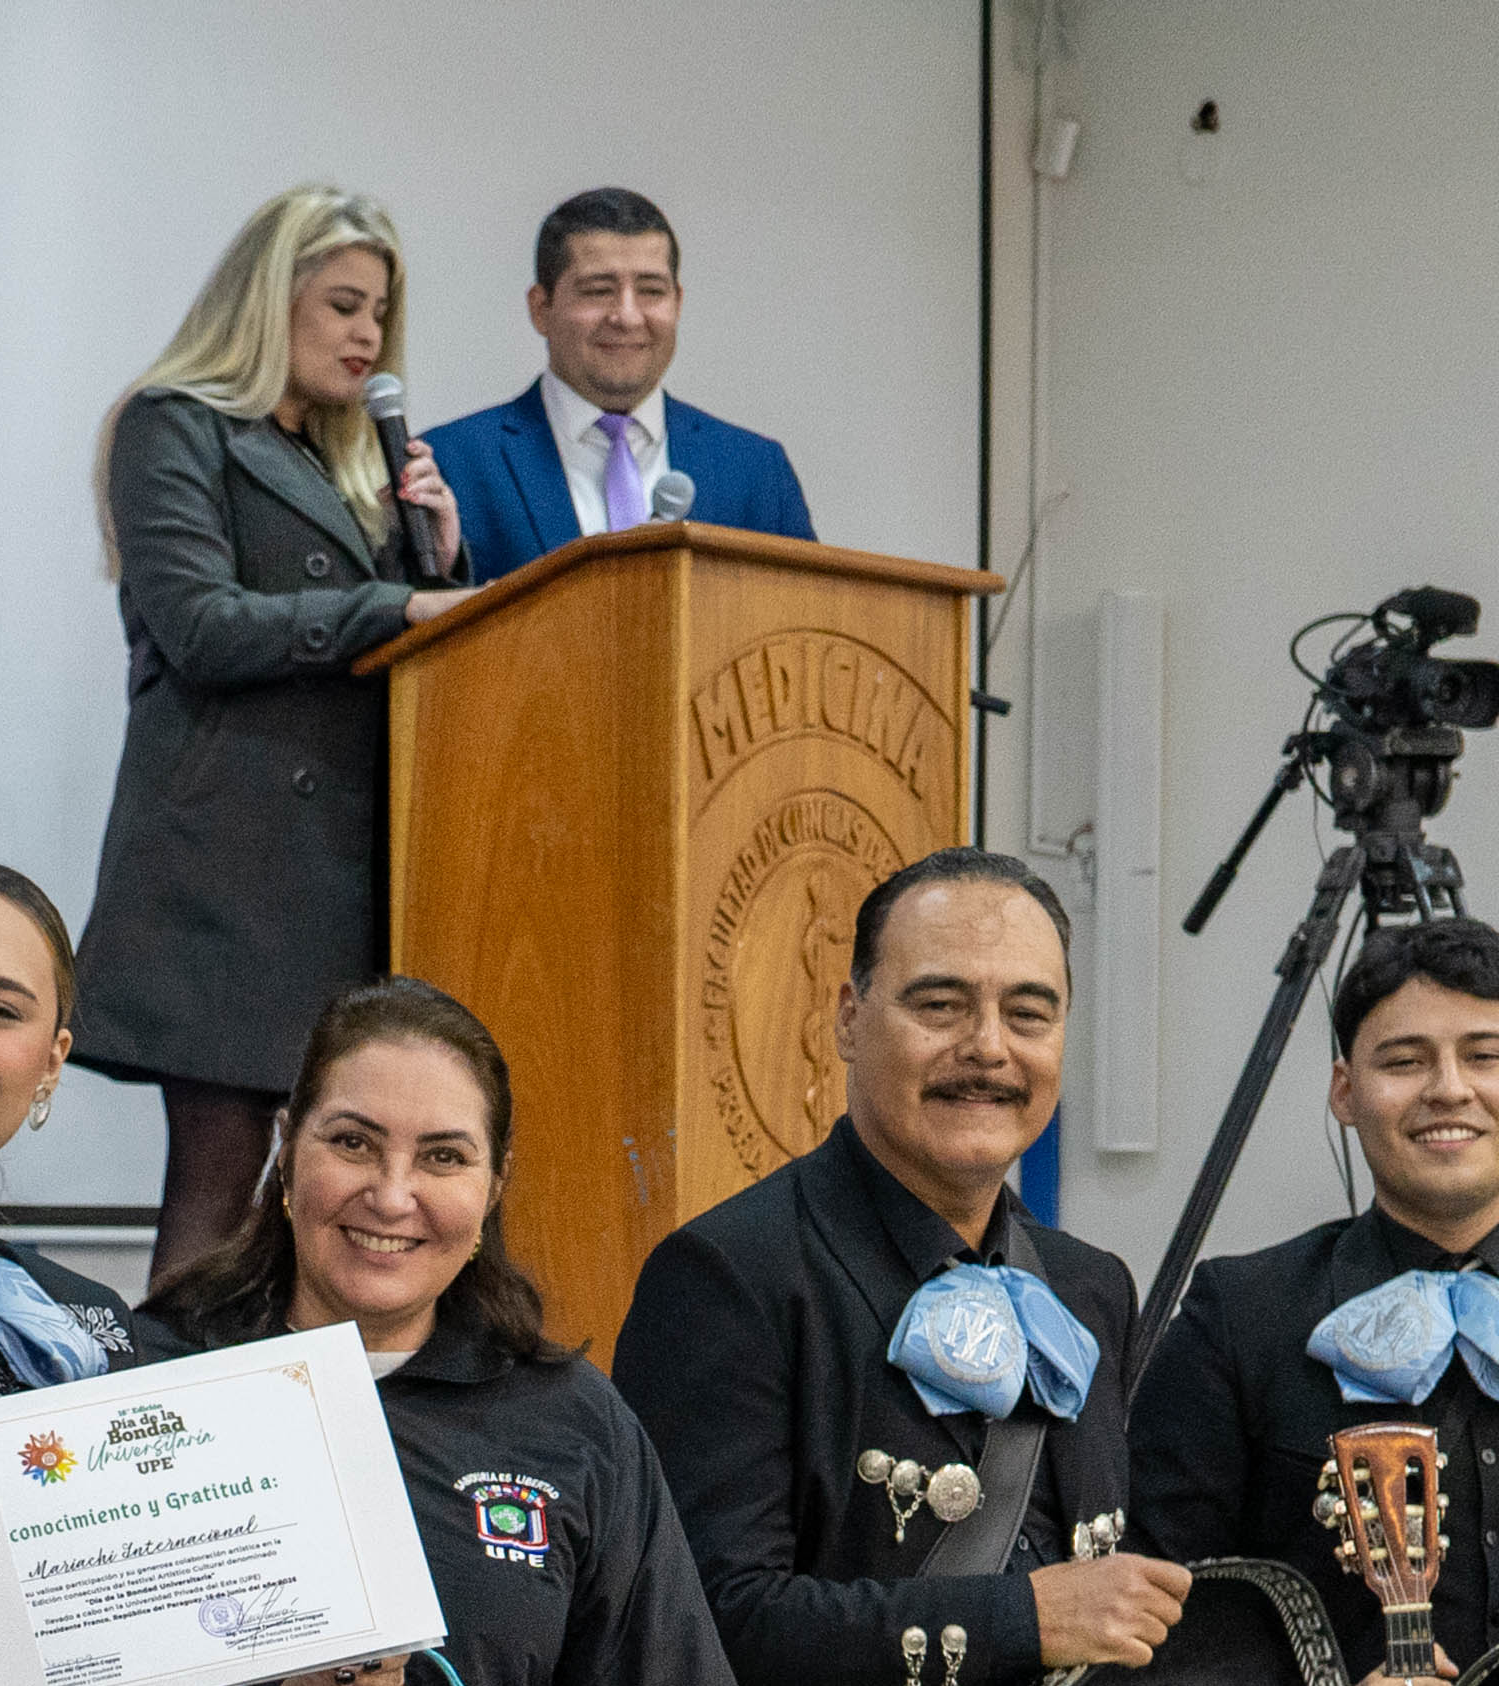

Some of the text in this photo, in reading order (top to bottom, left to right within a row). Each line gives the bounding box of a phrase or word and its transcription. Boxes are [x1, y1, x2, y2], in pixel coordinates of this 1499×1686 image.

[689, 636, 929, 801] MEDICINA
[106, 1418, 187, 1445] Bondad
[109, 1409, 177, 1432] Día de la
[87, 1429, 214, 1472] Universitaria
[135, 1456, 174, 1475] UPE
[147, 1499, 160, 1517] y
[165, 1475, 253, 1510] Gratitud
[259, 1476, 278, 1490] a:
[28, 1514, 260, 1580] Mariachi Internacional
[485, 1544, 545, 1568] UPE
[35, 1584, 63, 1595] valiosa
[64, 1573, 118, 1590] participación
[136, 1561, 173, 1575] generosa
[174, 1549, 226, 1565] colaboración
[227, 1543, 260, 1554] artística
[63, 1585, 111, 1600] consecutiva
[112, 1580, 125, 1589] del
[126, 1574, 155, 1585] festival
[157, 1568, 191, 1579] Artístico
[191, 1559, 224, 1572] Cultural
[226, 1549, 277, 1565] denominado
[39, 1623, 81, 1636] Presidente
[112, 1608, 151, 1620] República
[152, 1603, 165, 1612] del
[226, 1587, 246, 1597] junio
[247, 1583, 260, 1591] del
[81, 1608, 102, 1617] cabo
[124, 1592, 172, 1608] Universidad
[173, 1586, 204, 1597] Privada
[205, 1582, 218, 1590] del
[219, 1579, 237, 1587] Este
[103, 1594, 115, 1602] de
[125, 1584, 158, 1597] Bondad
